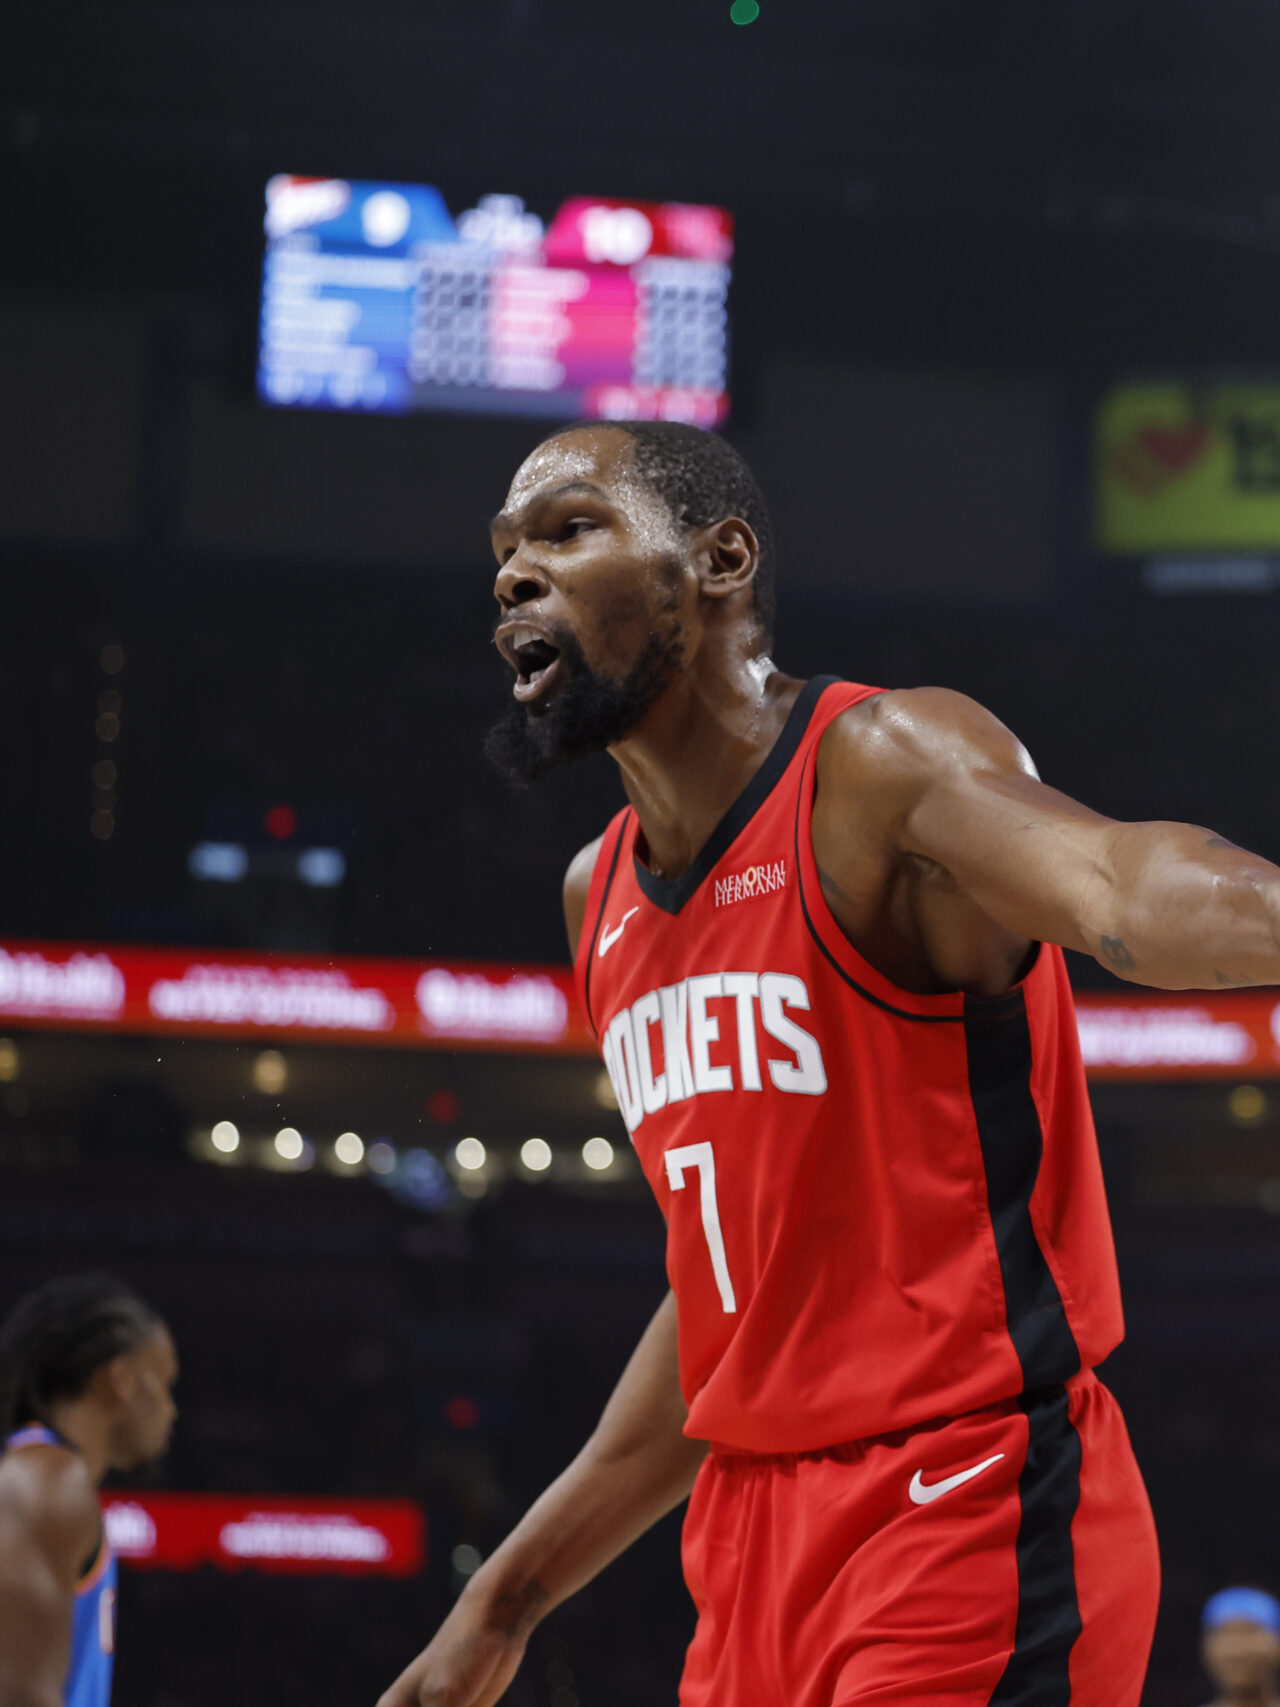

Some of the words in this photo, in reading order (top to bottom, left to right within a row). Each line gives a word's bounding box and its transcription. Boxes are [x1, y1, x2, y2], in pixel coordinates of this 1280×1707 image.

[715, 859, 785, 892] MEMORIAL
[715, 870, 786, 908] HERMANN
[665, 1140, 737, 1314] 7
